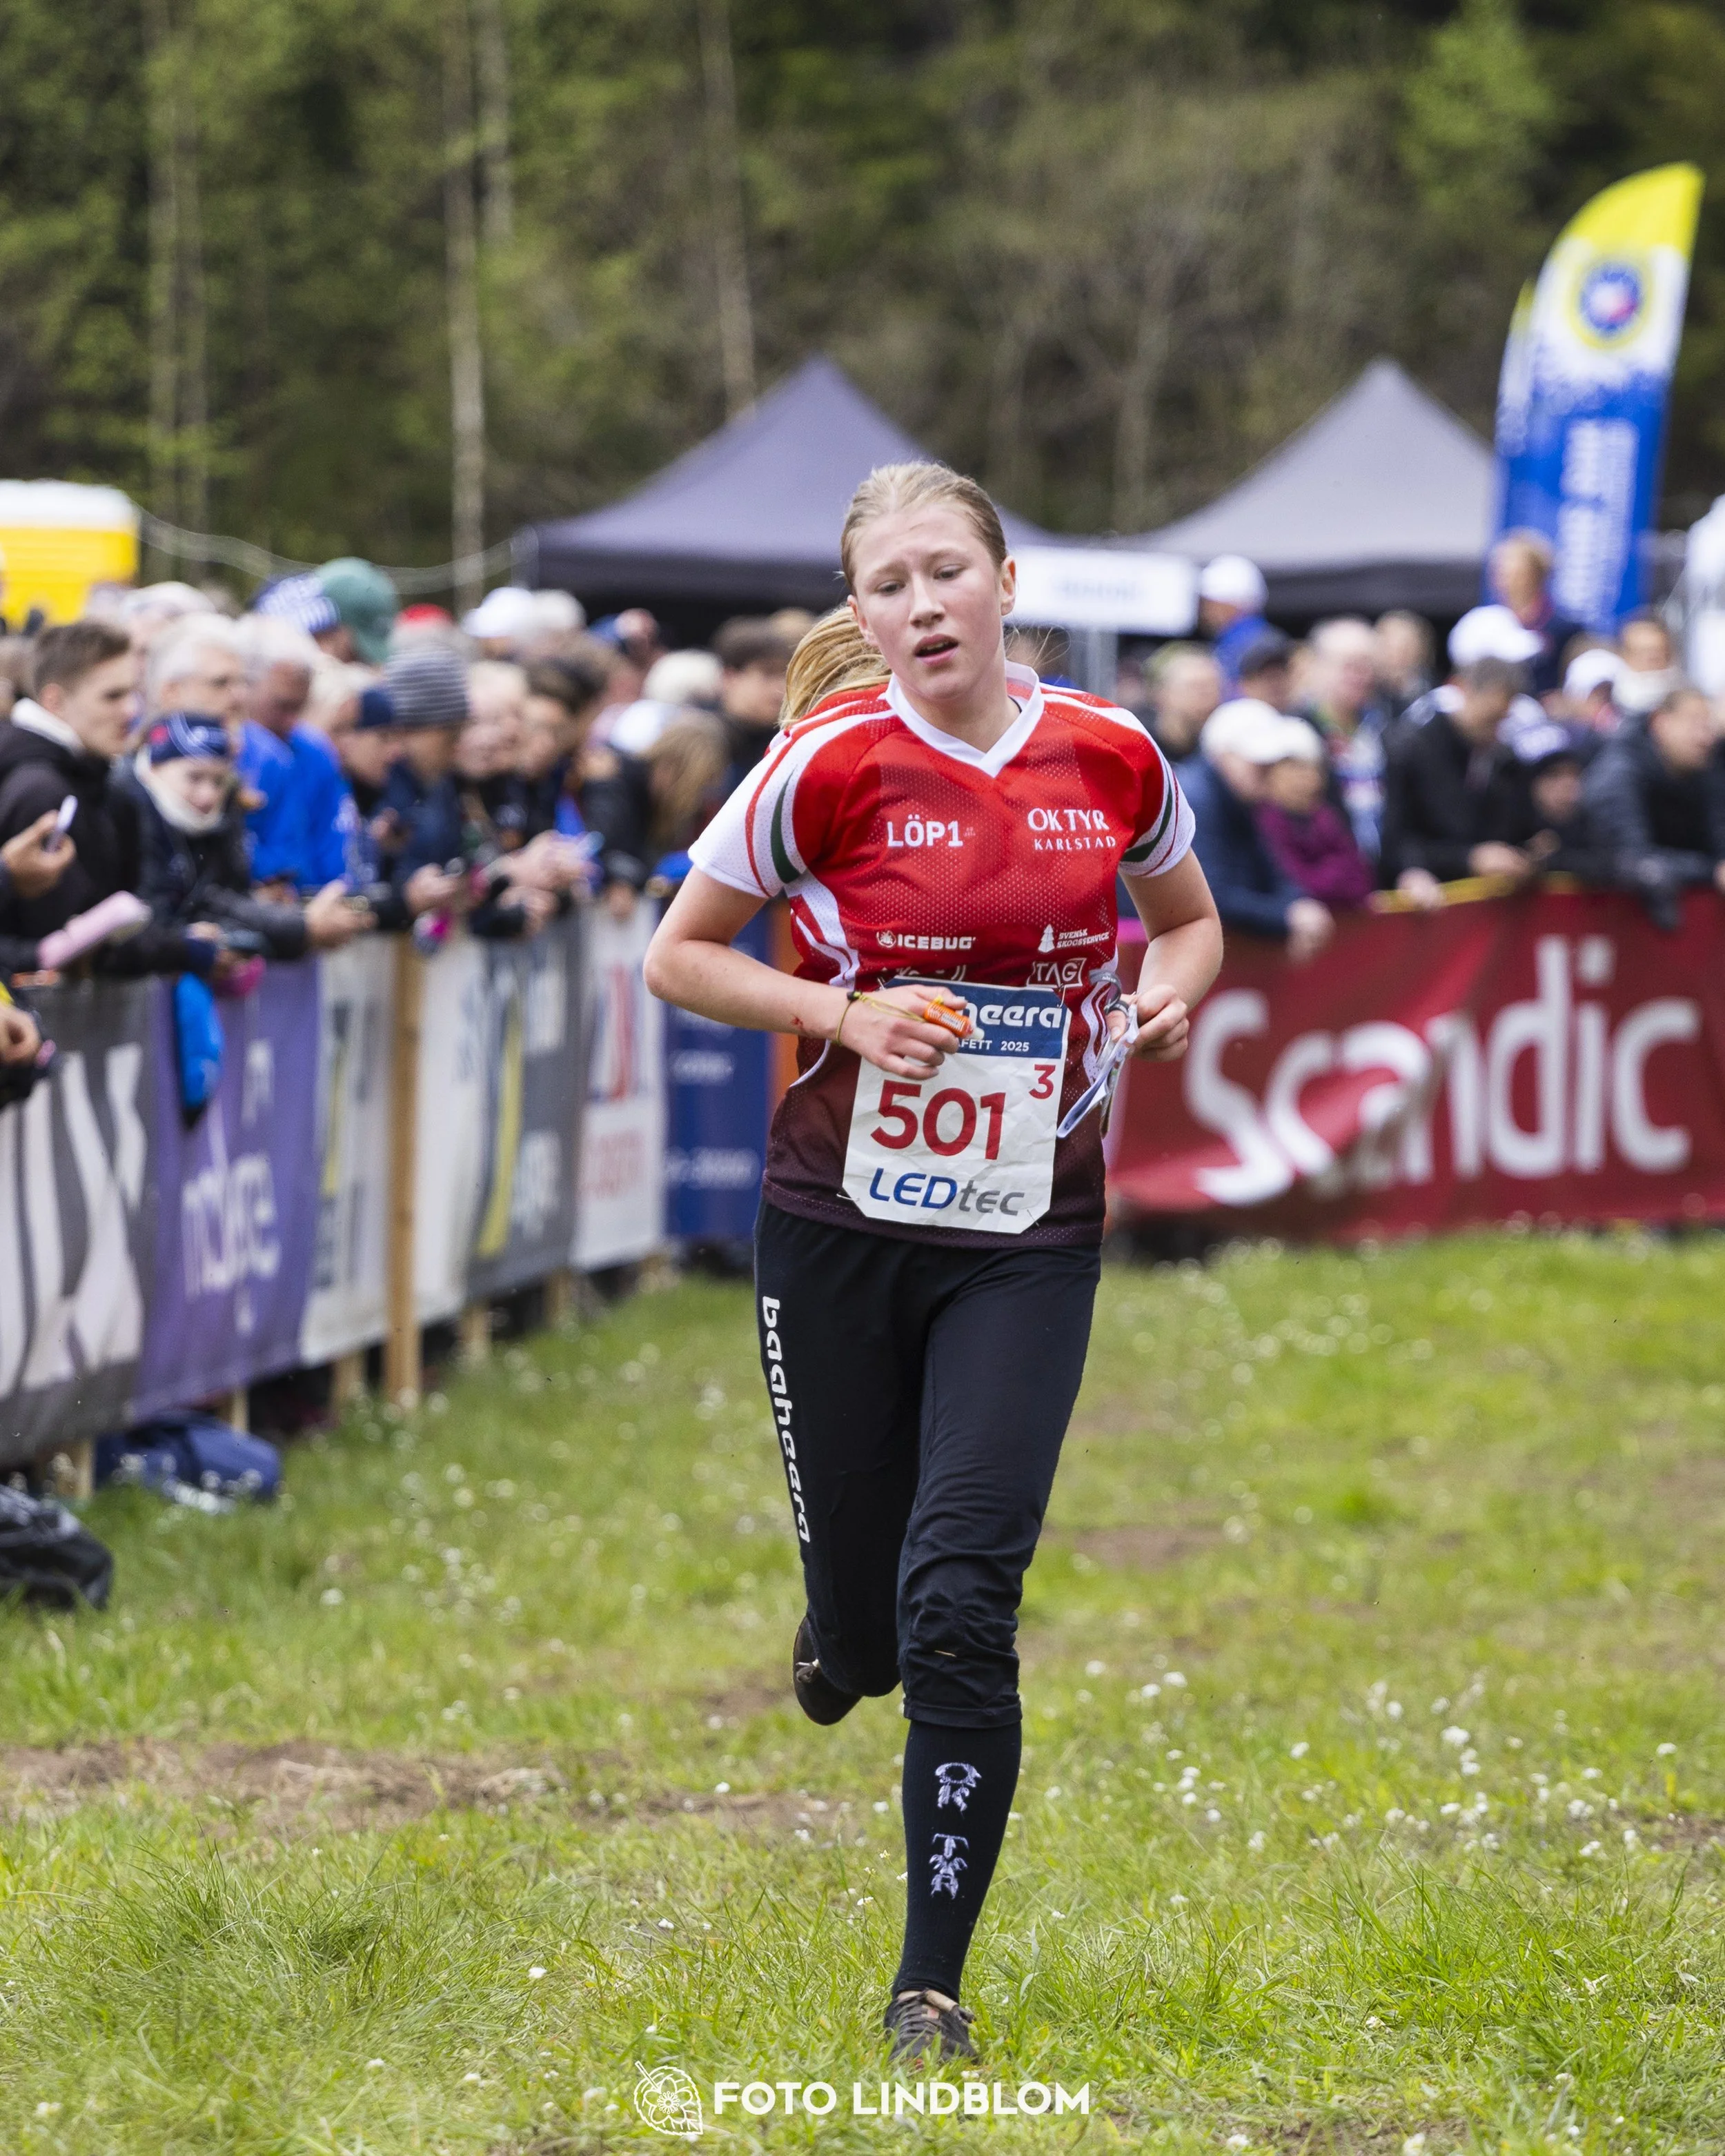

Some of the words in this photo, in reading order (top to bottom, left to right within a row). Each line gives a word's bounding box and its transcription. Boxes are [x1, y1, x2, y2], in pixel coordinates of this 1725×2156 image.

[887, 813, 964, 848] LÖP1
[1027, 807, 1063, 831] OK
[1063, 809, 1110, 831] TYR
[1034, 835, 1116, 851] KARLSTAD
[897, 933, 973, 950] ICEBUG
[1058, 928, 1088, 940] SVENSK
[1036, 962, 1078, 987] TAG
[956, 996, 1063, 1029] heera
[957, 1039, 993, 1051] FETT
[1000, 1040, 1030, 1052] 2025
[1028, 1064, 1056, 1100] 3
[1184, 933, 1702, 1207] Scandic
[870, 1079, 1007, 1160] 501
[869, 1167, 1025, 1216] LEDtec
[762, 1296, 811, 1543] baaheera
